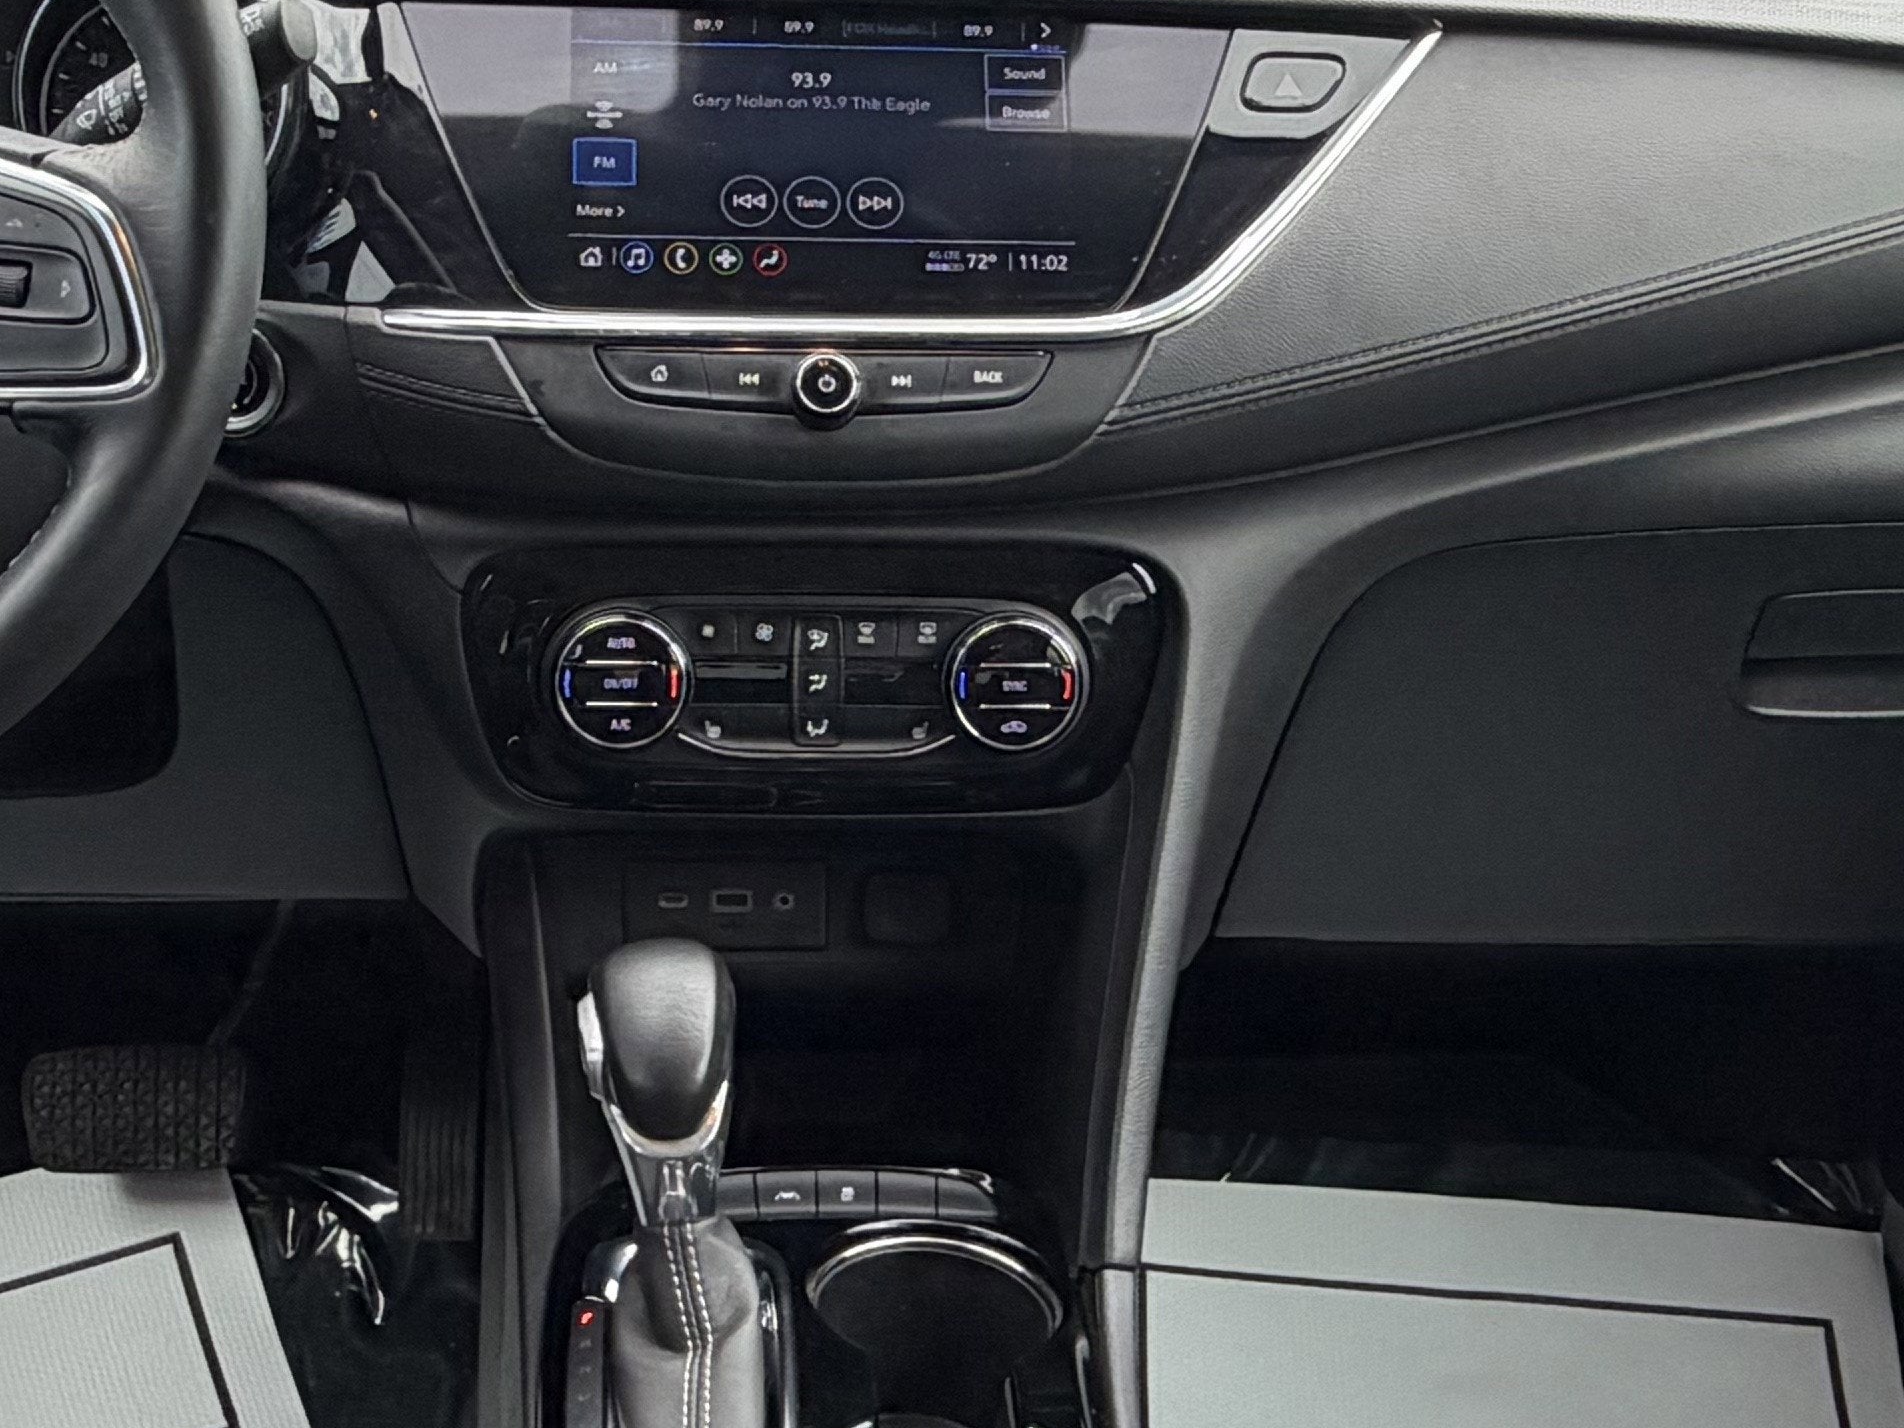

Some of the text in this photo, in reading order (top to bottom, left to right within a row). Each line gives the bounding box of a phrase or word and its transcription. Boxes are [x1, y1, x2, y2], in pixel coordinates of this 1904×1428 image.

[592, 62, 618, 74] AM
[1003, 66, 1047, 81] Sound
[791, 72, 833, 89] 93.9
[692, 93, 732, 111] Gary
[735, 94, 784, 110] Nolan
[786, 98, 808, 110] on
[812, 96, 848, 110] 93.9
[886, 98, 932, 115] Eagle
[1001, 105, 1051, 120] Browse
[593, 156, 616, 169] FM
[796, 194, 829, 209] Tune
[576, 204, 613, 218] More
[965, 253, 998, 270] 72°
[1019, 254, 1068, 271] 11:02
[973, 371, 1003, 384] BACK
